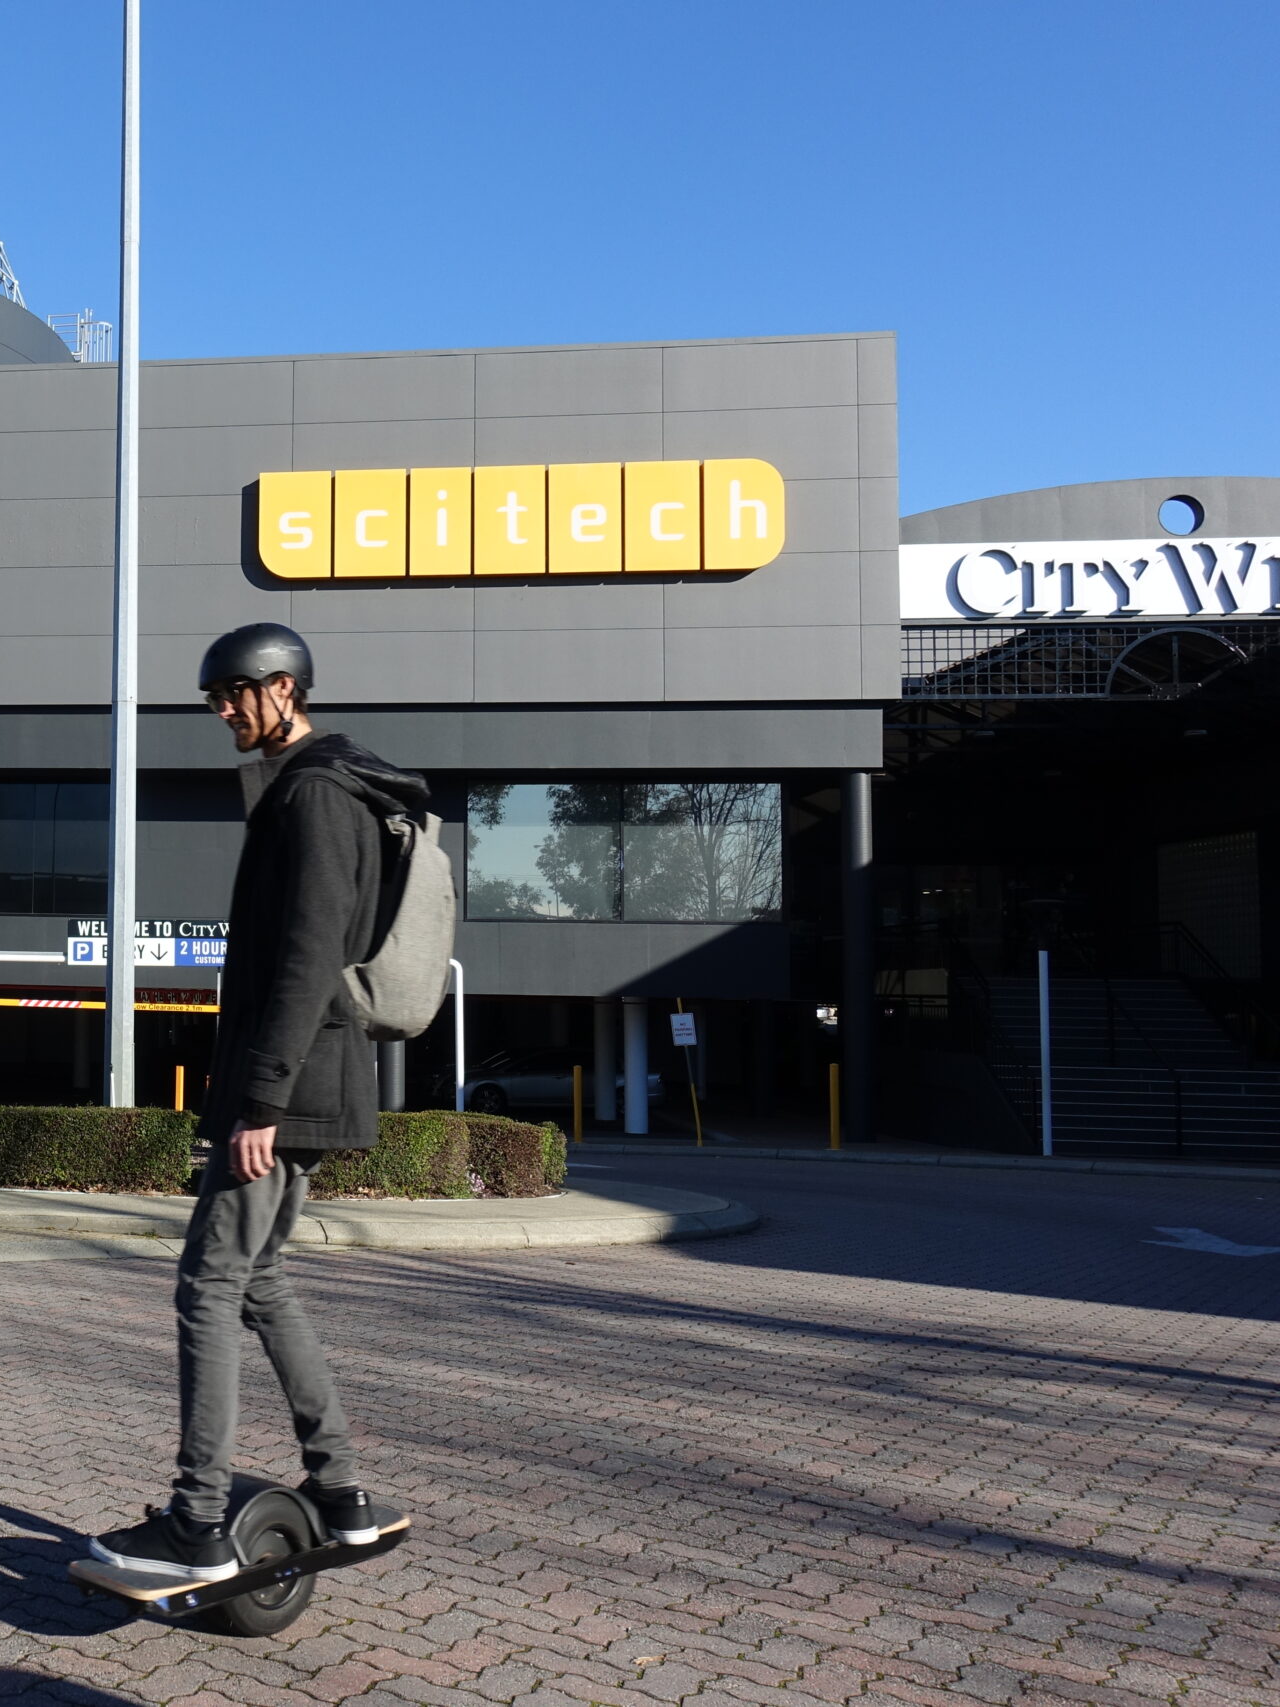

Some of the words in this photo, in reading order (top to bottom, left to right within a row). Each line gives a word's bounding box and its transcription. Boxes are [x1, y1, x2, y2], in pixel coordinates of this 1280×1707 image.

[278, 479, 768, 551] scitech
[153, 920, 172, 937] TO
[180, 941, 188, 956] 2
[192, 941, 228, 956] HOUR
[195, 956, 225, 964] CUSTOME
[148, 1003, 184, 1011] Clearance
